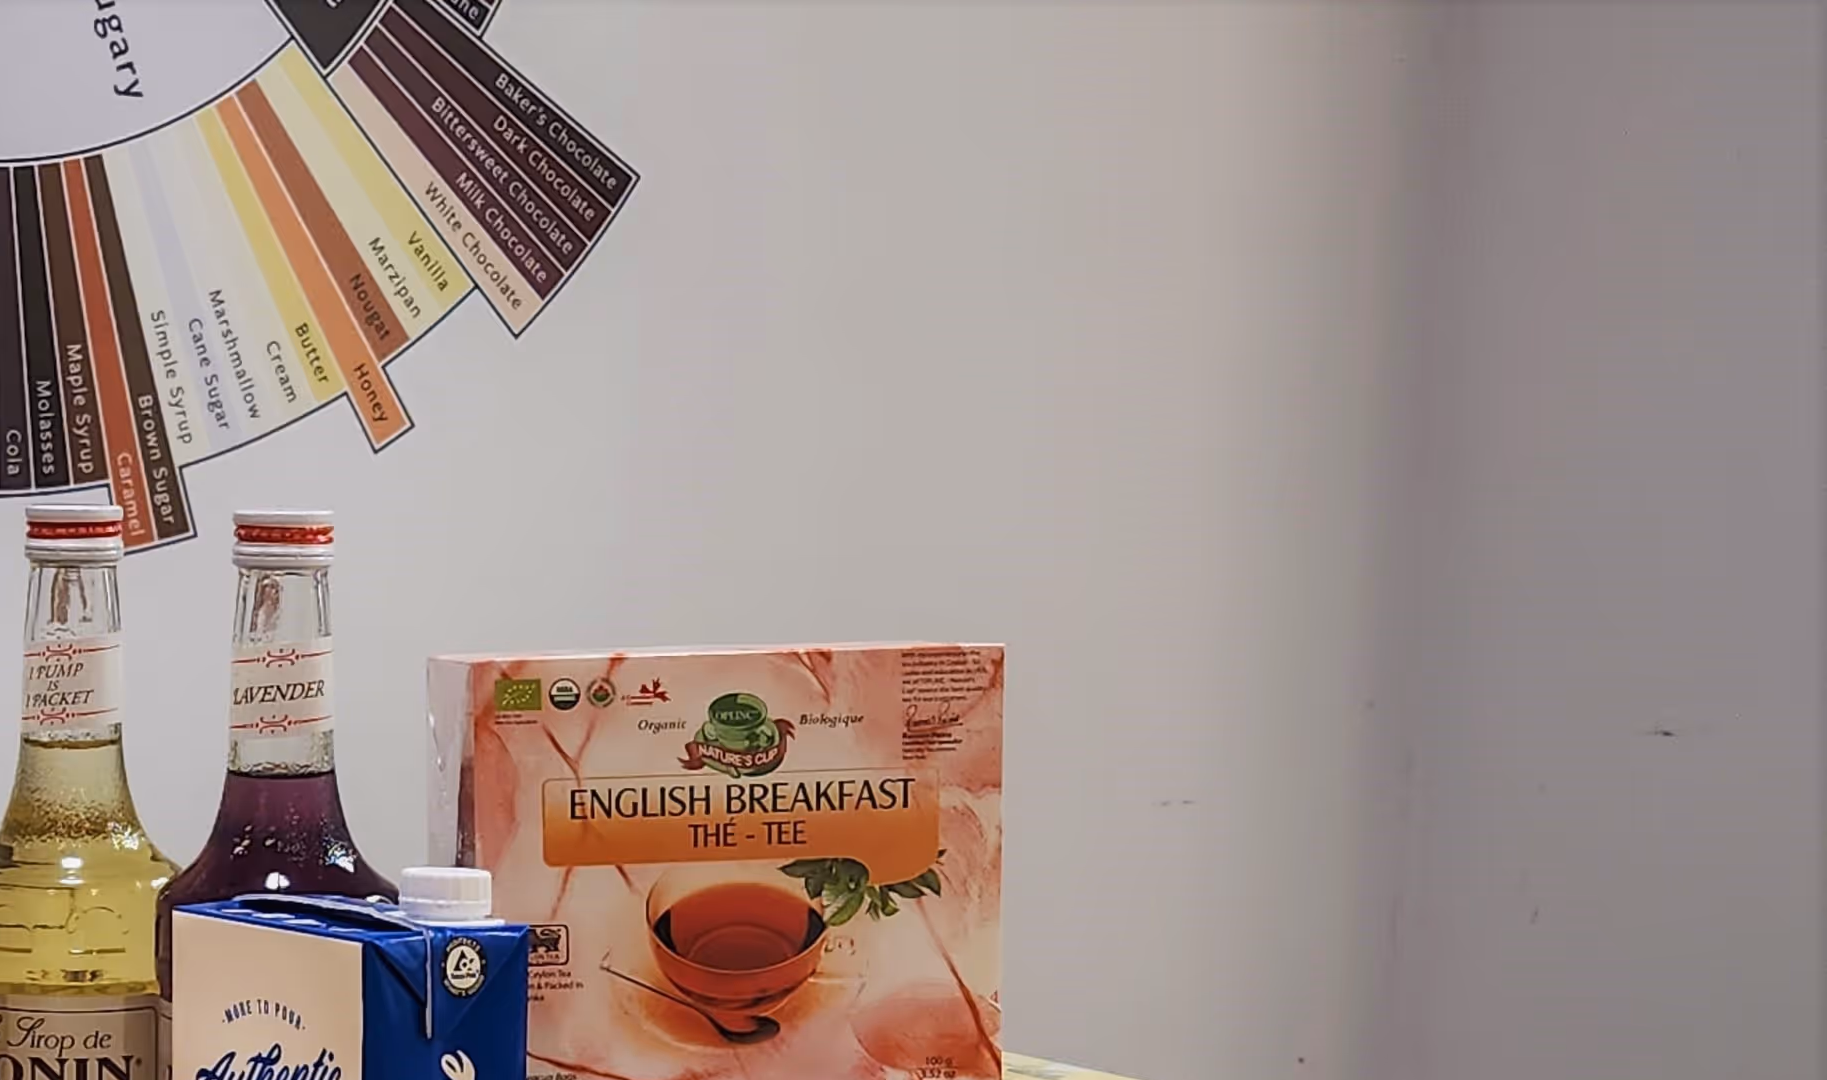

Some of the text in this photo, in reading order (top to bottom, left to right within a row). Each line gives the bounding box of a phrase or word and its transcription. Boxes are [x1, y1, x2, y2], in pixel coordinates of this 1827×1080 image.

[494, 72, 618, 191] Baker's Chocolate
[431, 96, 573, 255] Bittersweet Chocolate
[492, 114, 596, 223] Dark Chocolate
[407, 230, 449, 292] Vanilla
[425, 181, 523, 312] White Chocolate
[455, 171, 547, 285] Milk Chocolate
[349, 272, 390, 341] Nougat
[368, 236, 422, 320] Marzipan
[150, 309, 192, 445] Simple Syrup
[188, 317, 231, 430] Cane Sugar
[209, 288, 262, 420] Marshmallow
[265, 340, 297, 404] Cream
[294, 321, 330, 385] Butter
[65, 344, 95, 474] Maple Syrup
[353, 361, 389, 424] Honey
[5, 428, 22, 476] Cola
[36, 379, 56, 476] Molasses
[137, 394, 175, 526] Brown Sugar
[116, 451, 144, 537] Caramel
[33, 689, 94, 708] PACKET
[47, 680, 59, 692] IS
[233, 680, 325, 706] LAVENDER
[637, 719, 687, 735] Organic
[799, 713, 865, 729] Biologique
[698, 744, 778, 767] NATURE'S CUP
[569, 778, 916, 820] ENGLISH BREAKFAST
[688, 818, 737, 848] THÉ
[763, 820, 807, 846] TEE
[6, 1016, 75, 1057] Sirop
[83, 1031, 112, 1049] de
